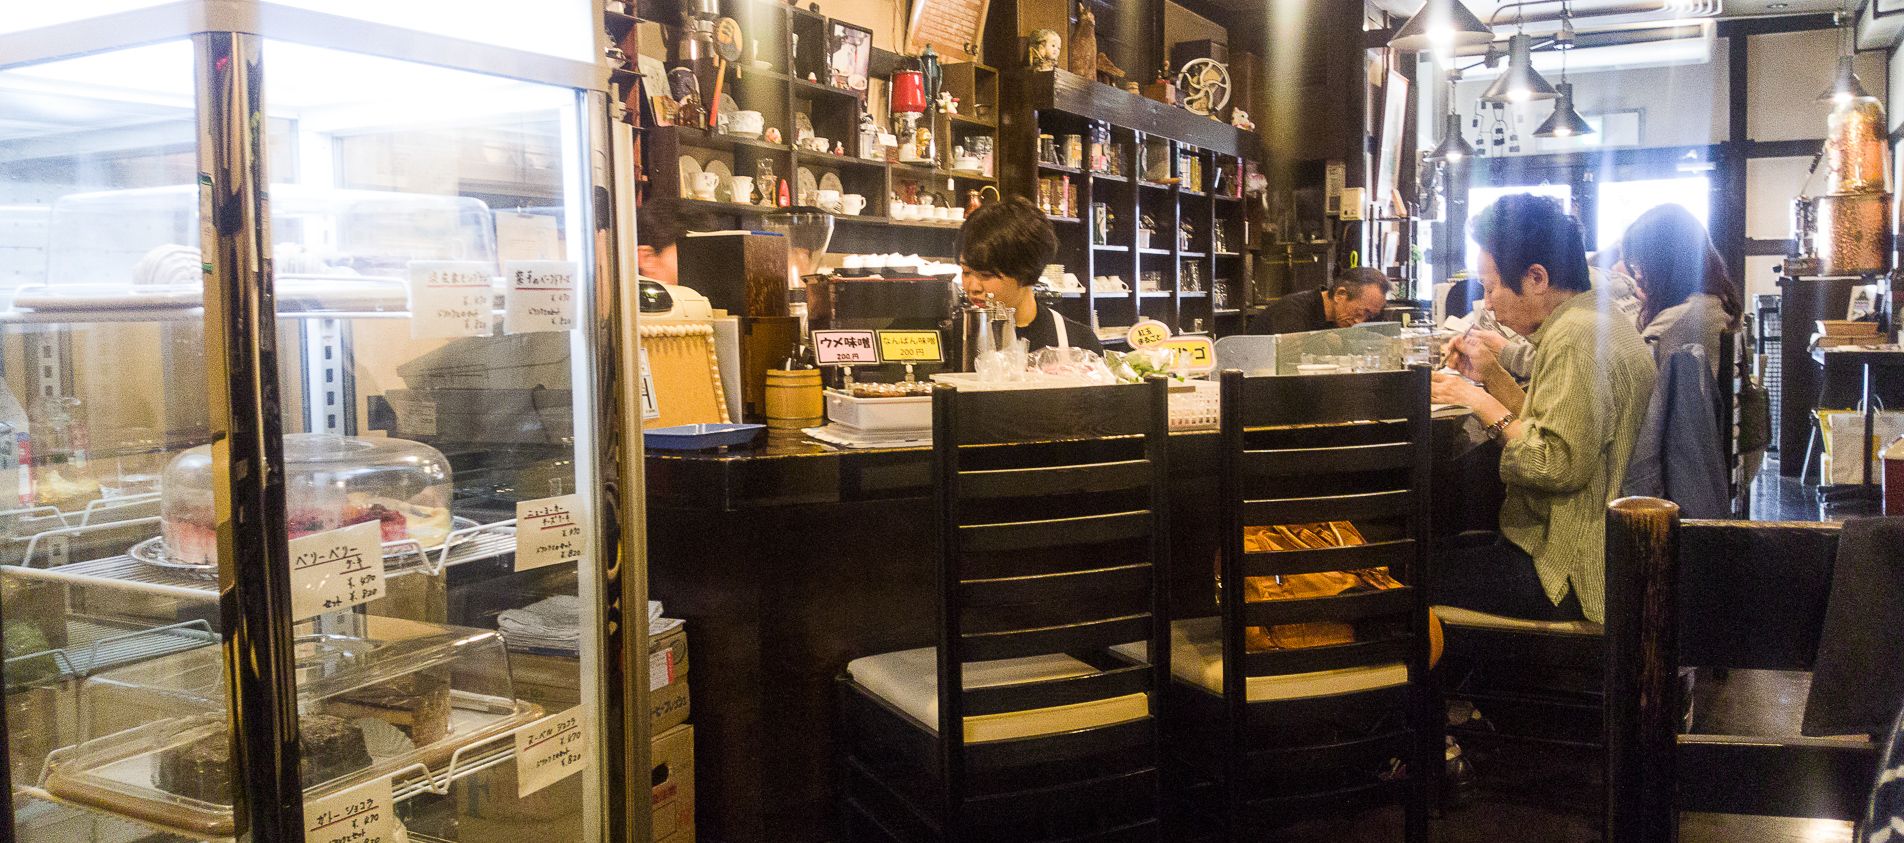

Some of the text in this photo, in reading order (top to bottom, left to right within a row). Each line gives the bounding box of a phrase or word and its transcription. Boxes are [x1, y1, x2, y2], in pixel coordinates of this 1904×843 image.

[820, 337, 871, 349] ウメ味噌
[883, 337, 936, 345] なんばん味噌
[345, 556, 363, 570] ケーキ
[316, 798, 374, 827] ガトー ショコラ
